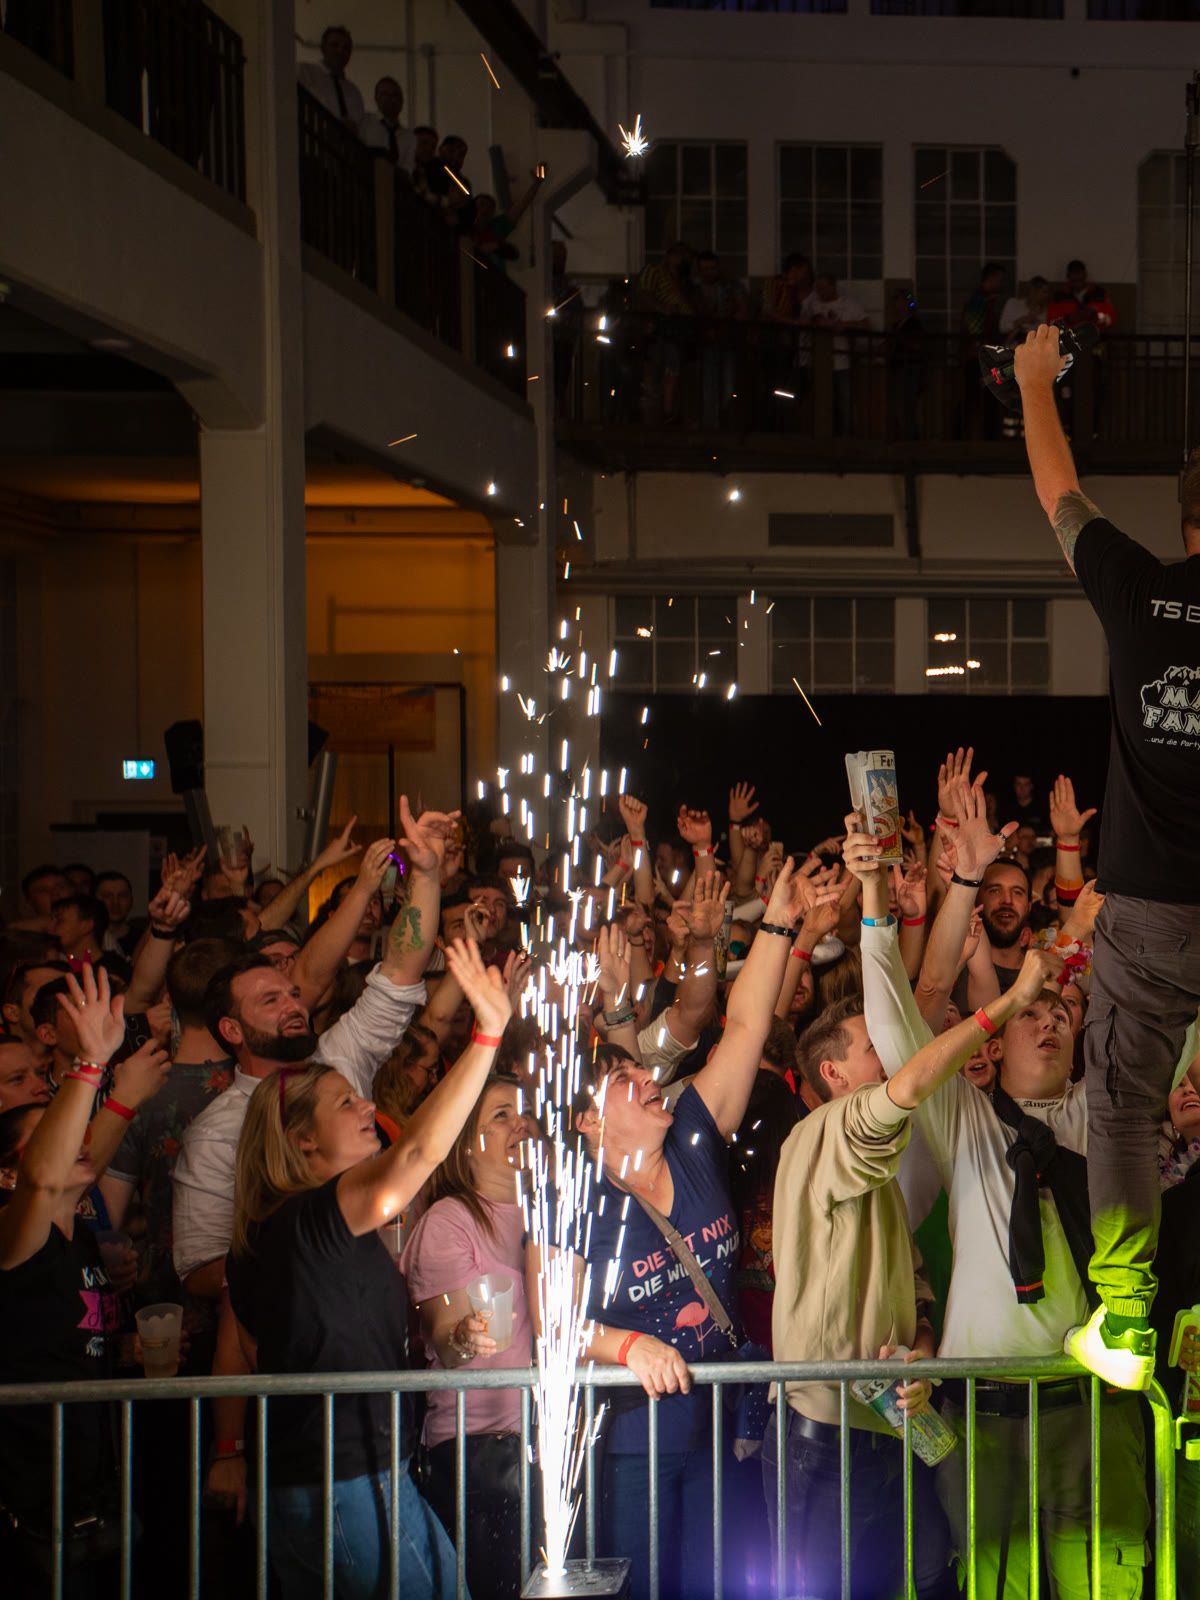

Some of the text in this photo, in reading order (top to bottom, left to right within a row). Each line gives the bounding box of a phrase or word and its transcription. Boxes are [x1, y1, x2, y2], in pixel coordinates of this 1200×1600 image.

[1151, 600, 1182, 619] TS
[632, 1214, 732, 1278] DIE TT NIX
[628, 1274, 664, 1303] DIE
